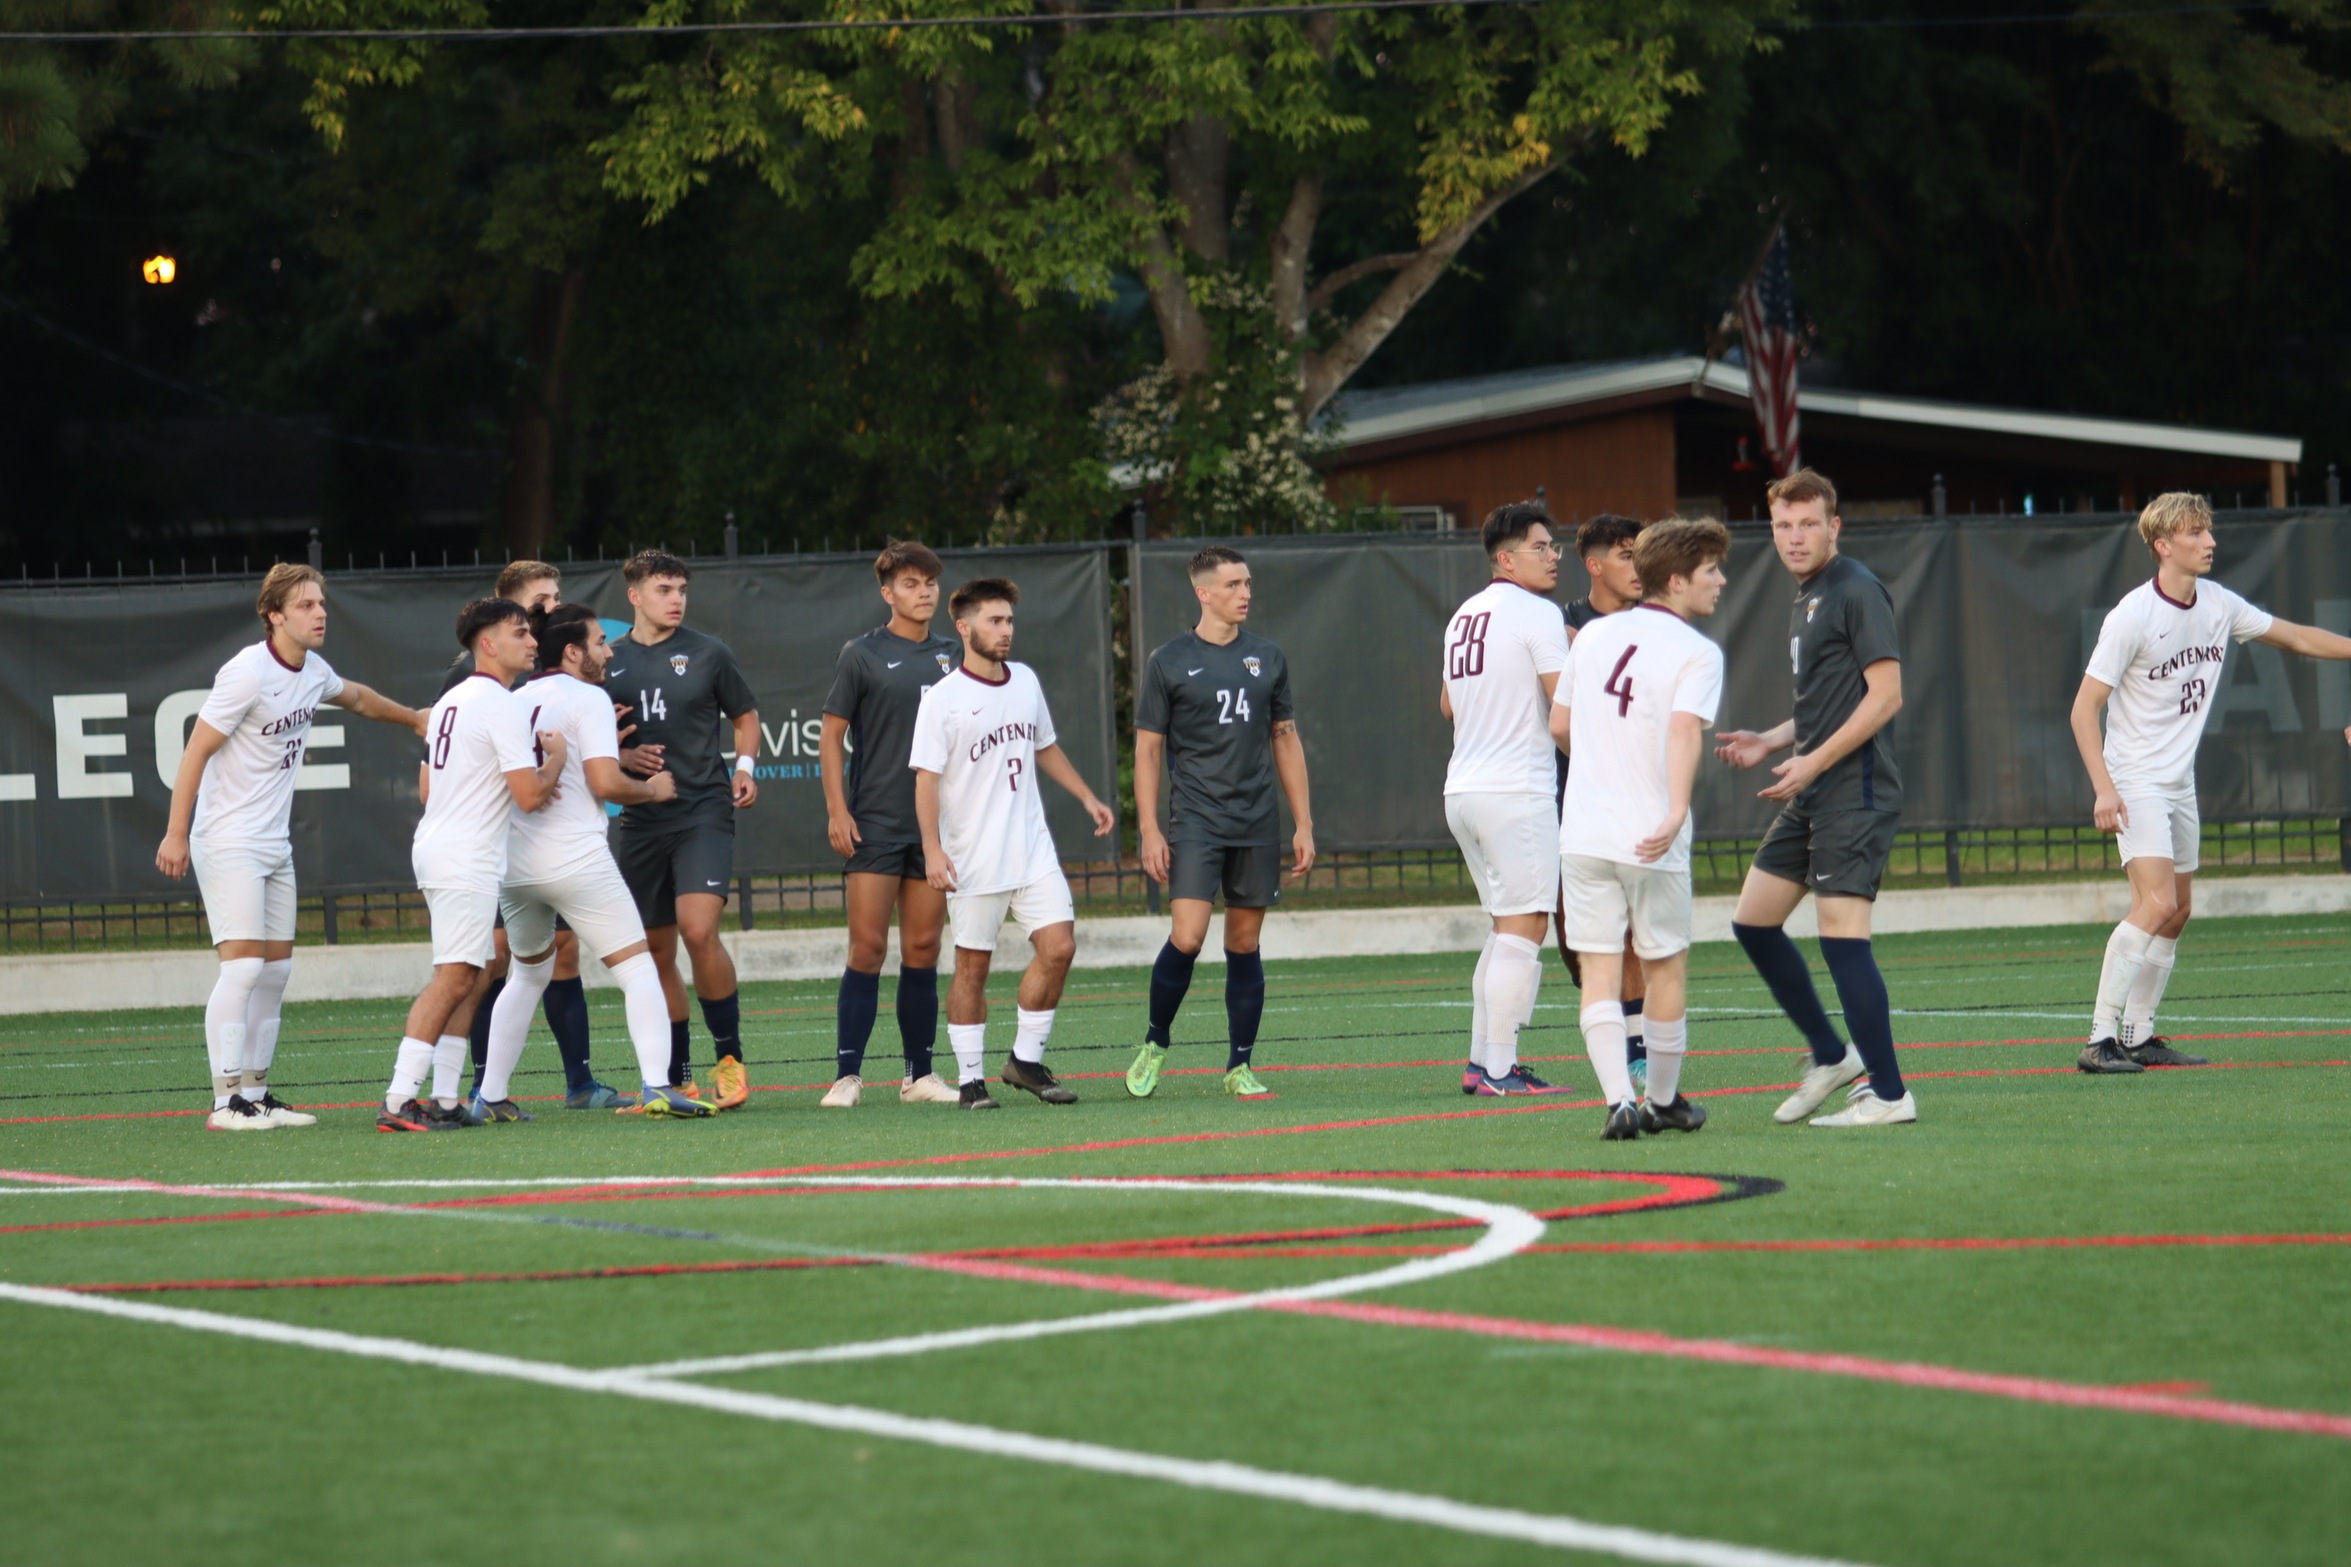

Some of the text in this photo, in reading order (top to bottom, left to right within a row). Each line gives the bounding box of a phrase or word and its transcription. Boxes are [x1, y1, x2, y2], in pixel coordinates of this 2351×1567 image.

[1450, 611, 1491, 680] 28
[2148, 645, 2224, 681] CENTENAR
[640, 687, 667, 722] 14
[1216, 687, 1250, 724] 24
[1604, 644, 1639, 718] 4
[434, 706, 458, 770] 8
